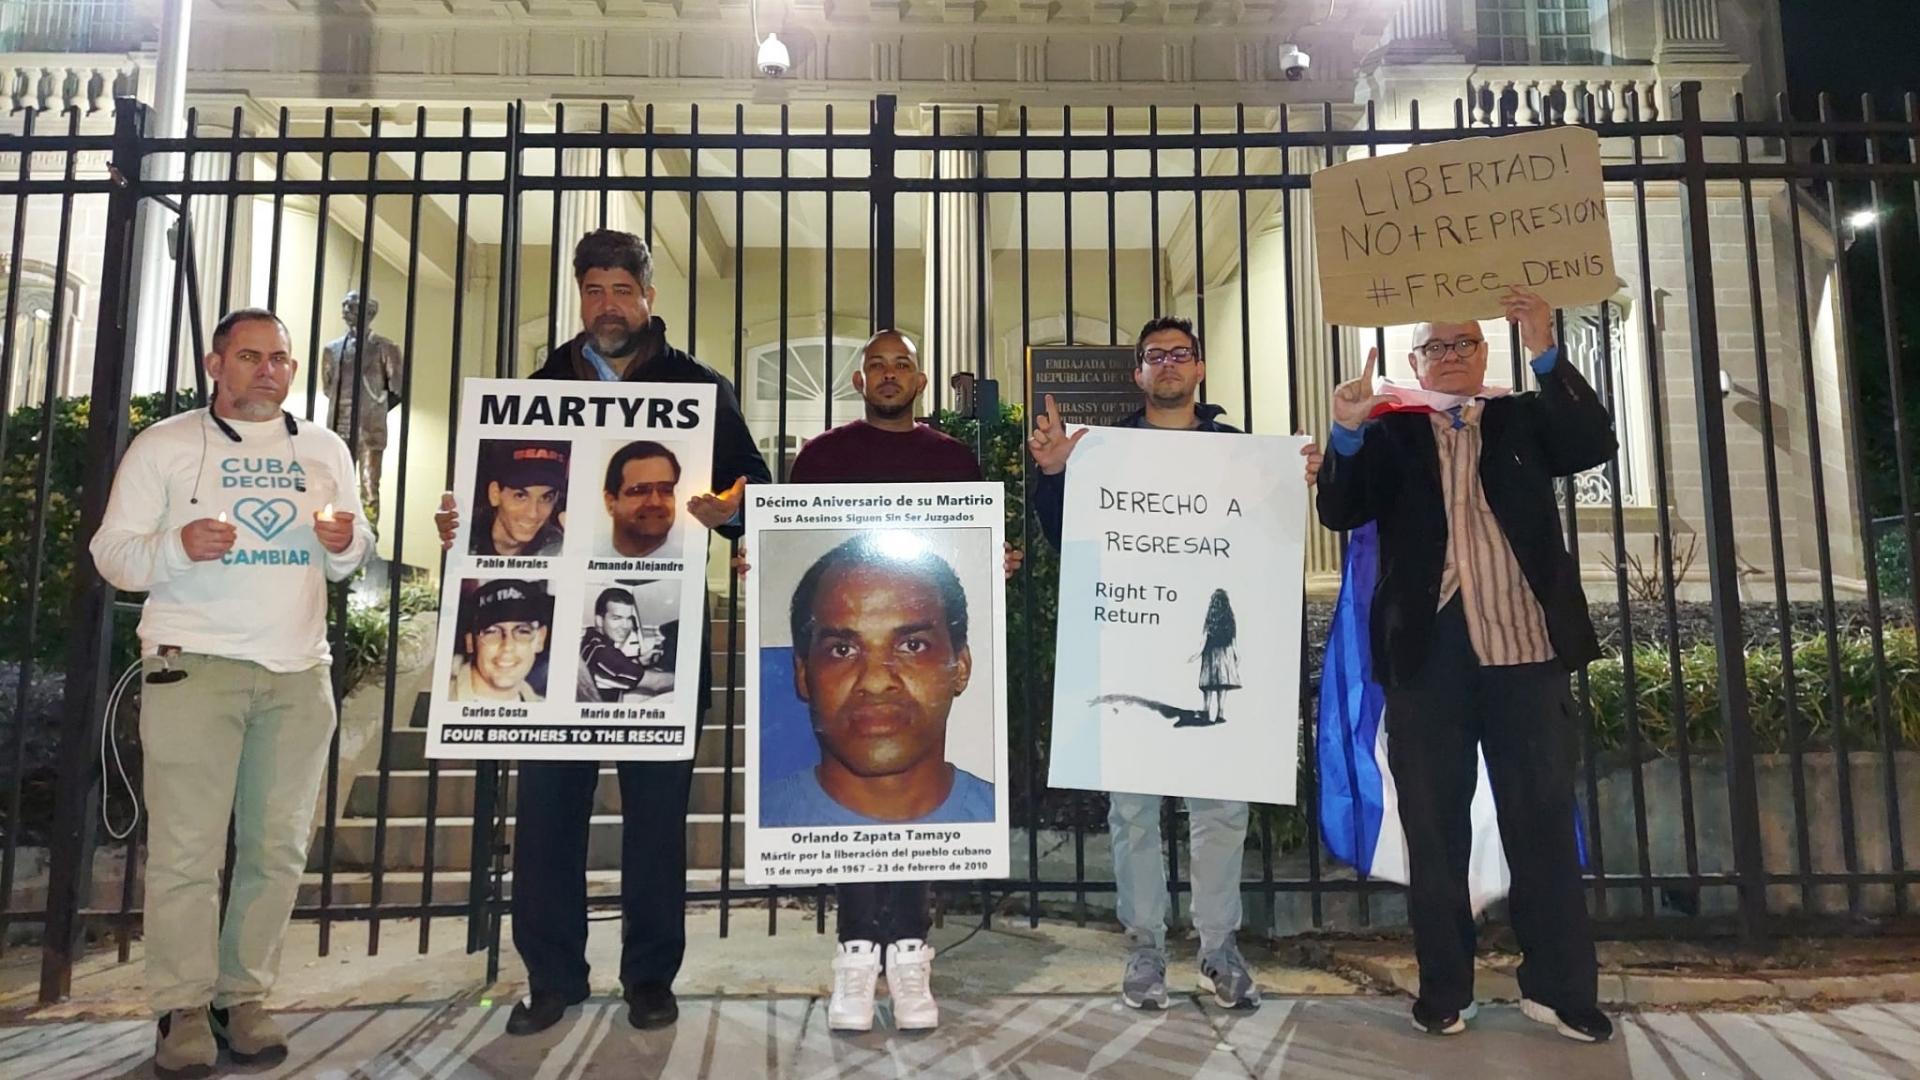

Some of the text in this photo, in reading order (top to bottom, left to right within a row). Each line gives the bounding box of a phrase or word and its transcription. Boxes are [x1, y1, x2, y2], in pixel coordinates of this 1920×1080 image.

[1354, 143, 1570, 217] LIBERTAD!
[1045, 359, 1105, 369] EMBAJADA
[1036, 372, 1100, 383] REPUBLICA
[480, 394, 700, 429] MARTYRS
[1058, 402, 1098, 413] BASSY
[1102, 402, 1116, 413] OF
[221, 457, 306, 476] CUBA
[222, 475, 306, 489] DECIDE
[755, 494, 994, 508] Décimo Aniversario de su Martirio
[1099, 486, 1242, 518] DERECHO A
[773, 512, 975, 524] Sus Asesinos Siguen Sin Ser Juzgados
[1104, 530, 1231, 559] REGRESAR
[222, 548, 311, 566] CAMBIAR
[476, 557, 549, 570] Pablo Morales
[587, 559, 684, 572] Armando Alejandre
[1095, 581, 1178, 603] Right To
[1094, 606, 1160, 625] Return
[461, 705, 528, 718] Carlos Costa
[580, 707, 666, 720] Mario de la Peña
[442, 727, 683, 743] FOUR BROTHERS TO THE RESCUE
[791, 829, 961, 845] Orlando Zapata Tamayo
[760, 846, 992, 863] Mártir por la liberación del pueblo cubano
[764, 867, 775, 876] 15
[778, 866, 791, 875] de
[794, 868, 823, 877] mayo
[826, 865, 839, 874] de
[842, 864, 865, 873] 1967
[876, 863, 889, 873] 23
[892, 863, 904, 872] de
[907, 862, 946, 872] febrero
[948, 862, 961, 871] de
[964, 861, 988, 871] 2010
